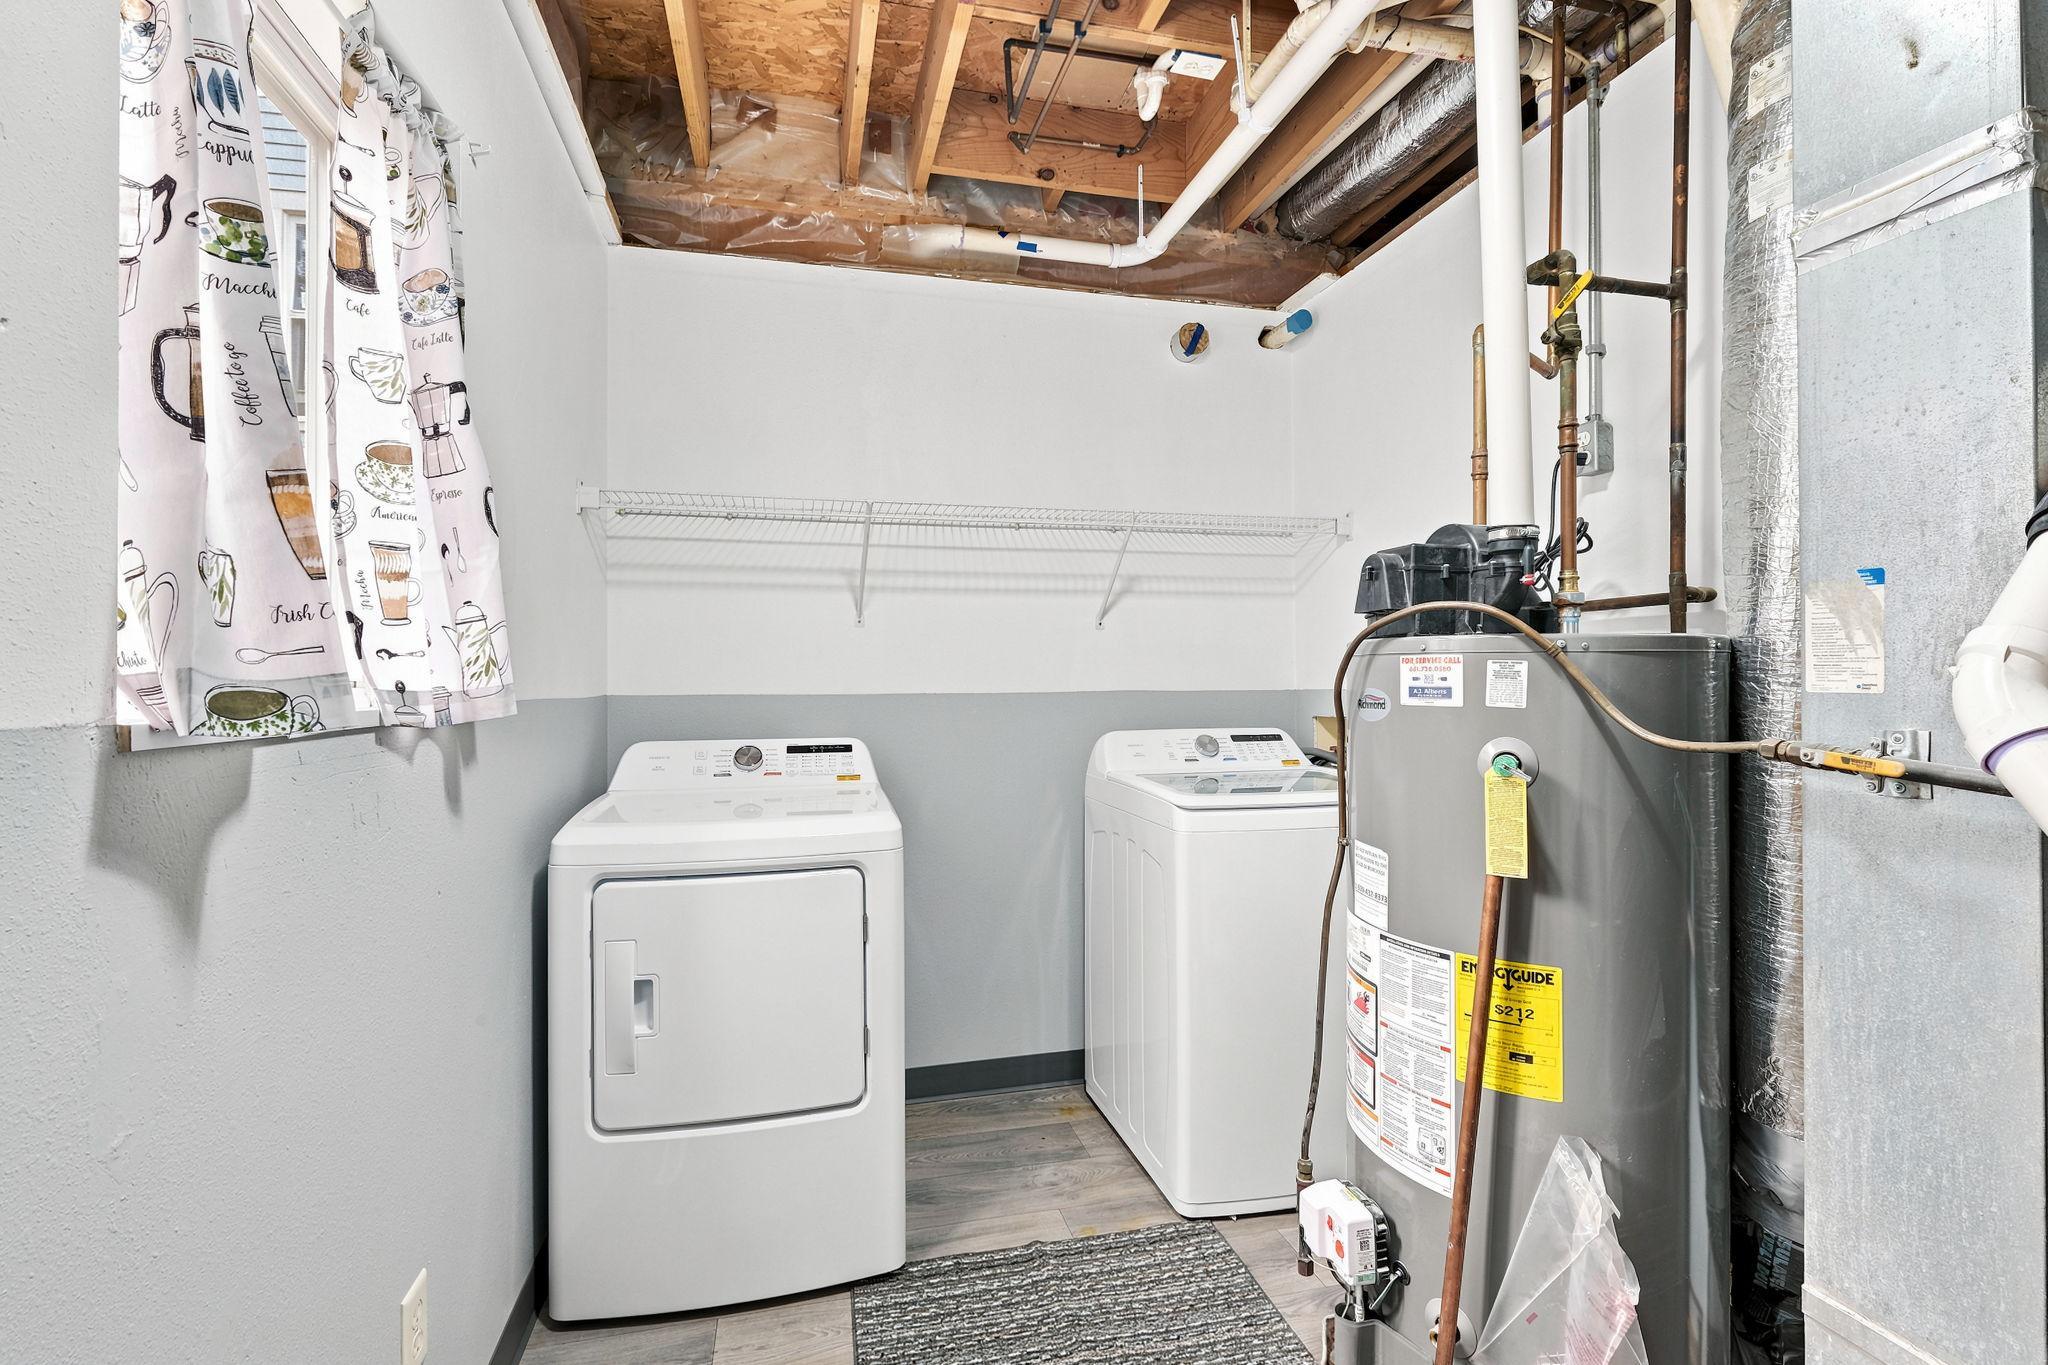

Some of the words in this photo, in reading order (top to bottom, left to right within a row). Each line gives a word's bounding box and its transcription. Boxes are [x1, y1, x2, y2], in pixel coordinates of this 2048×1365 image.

[223, 341, 248, 360] go
[224, 362, 244, 379] to
[231, 379, 263, 427] Coffee
[431, 488, 463, 504] Espresso
[269, 603, 315, 624] Irish
[318, 602, 335, 619] C
[1461, 960, 1555, 986] ENGYGUIDE
